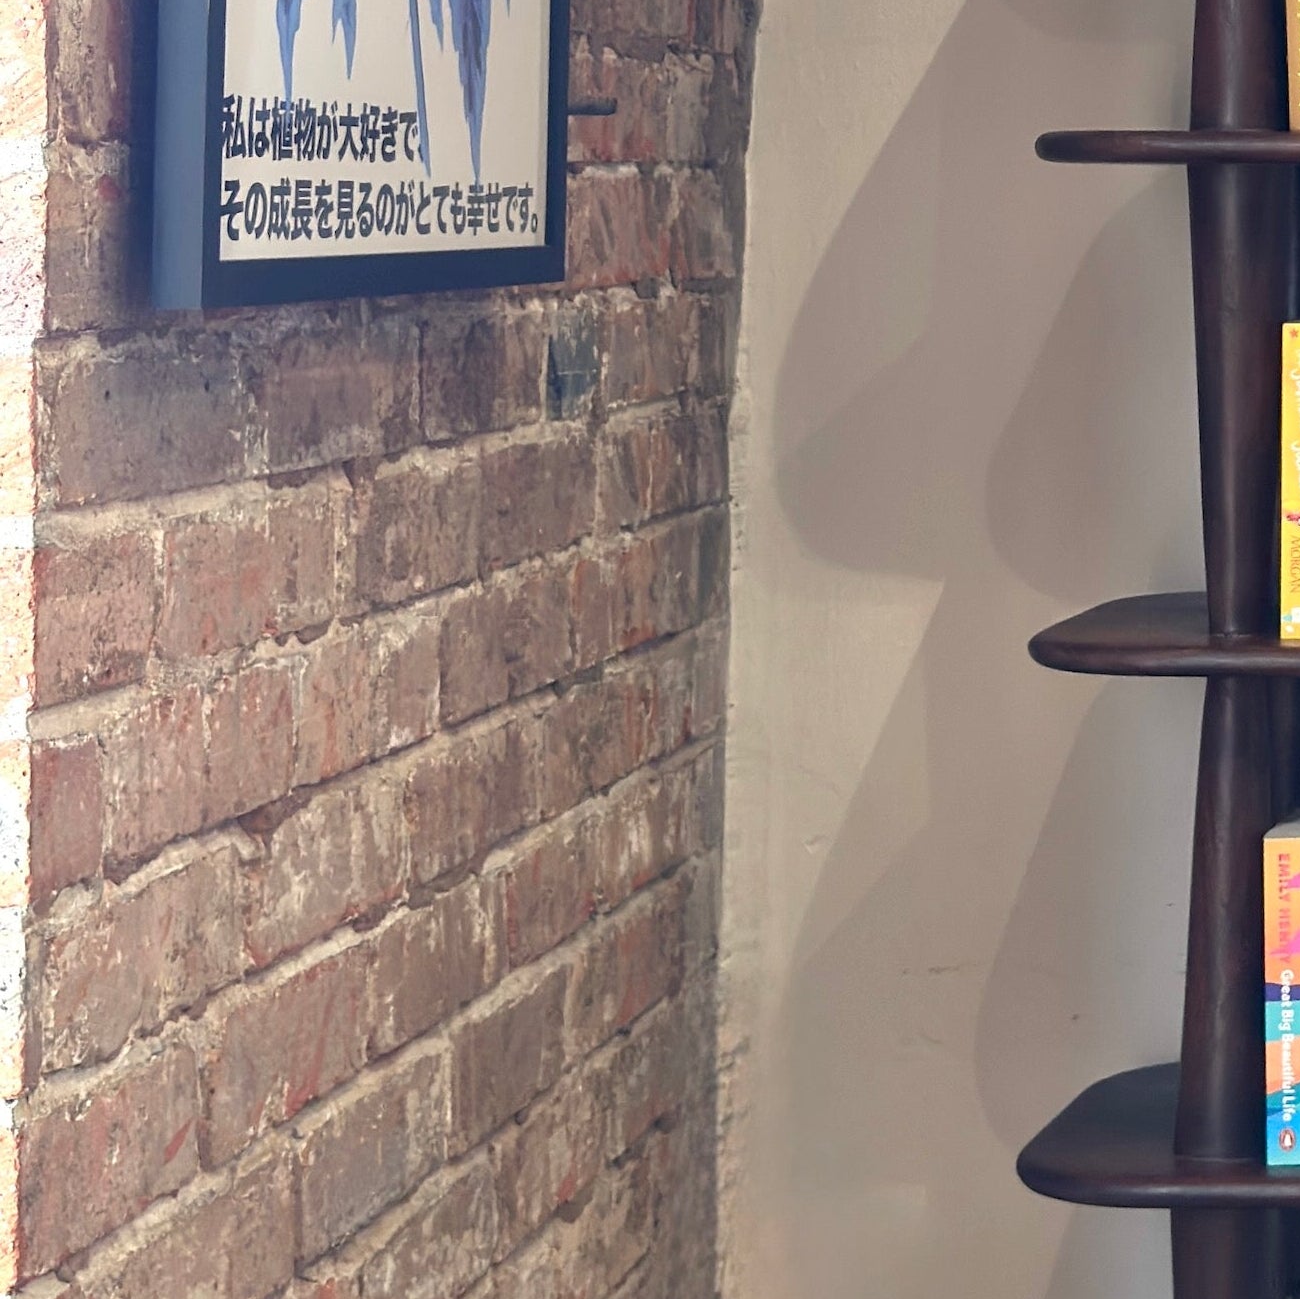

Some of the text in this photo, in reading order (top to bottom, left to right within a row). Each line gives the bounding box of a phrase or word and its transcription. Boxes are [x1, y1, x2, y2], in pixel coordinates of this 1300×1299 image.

[220, 178, 538, 241] その成長を見るのがとても幸せです。
[1278, 853, 1291, 900] EMILY
[1278, 969, 1296, 1121] Great Big Beautiful Life
